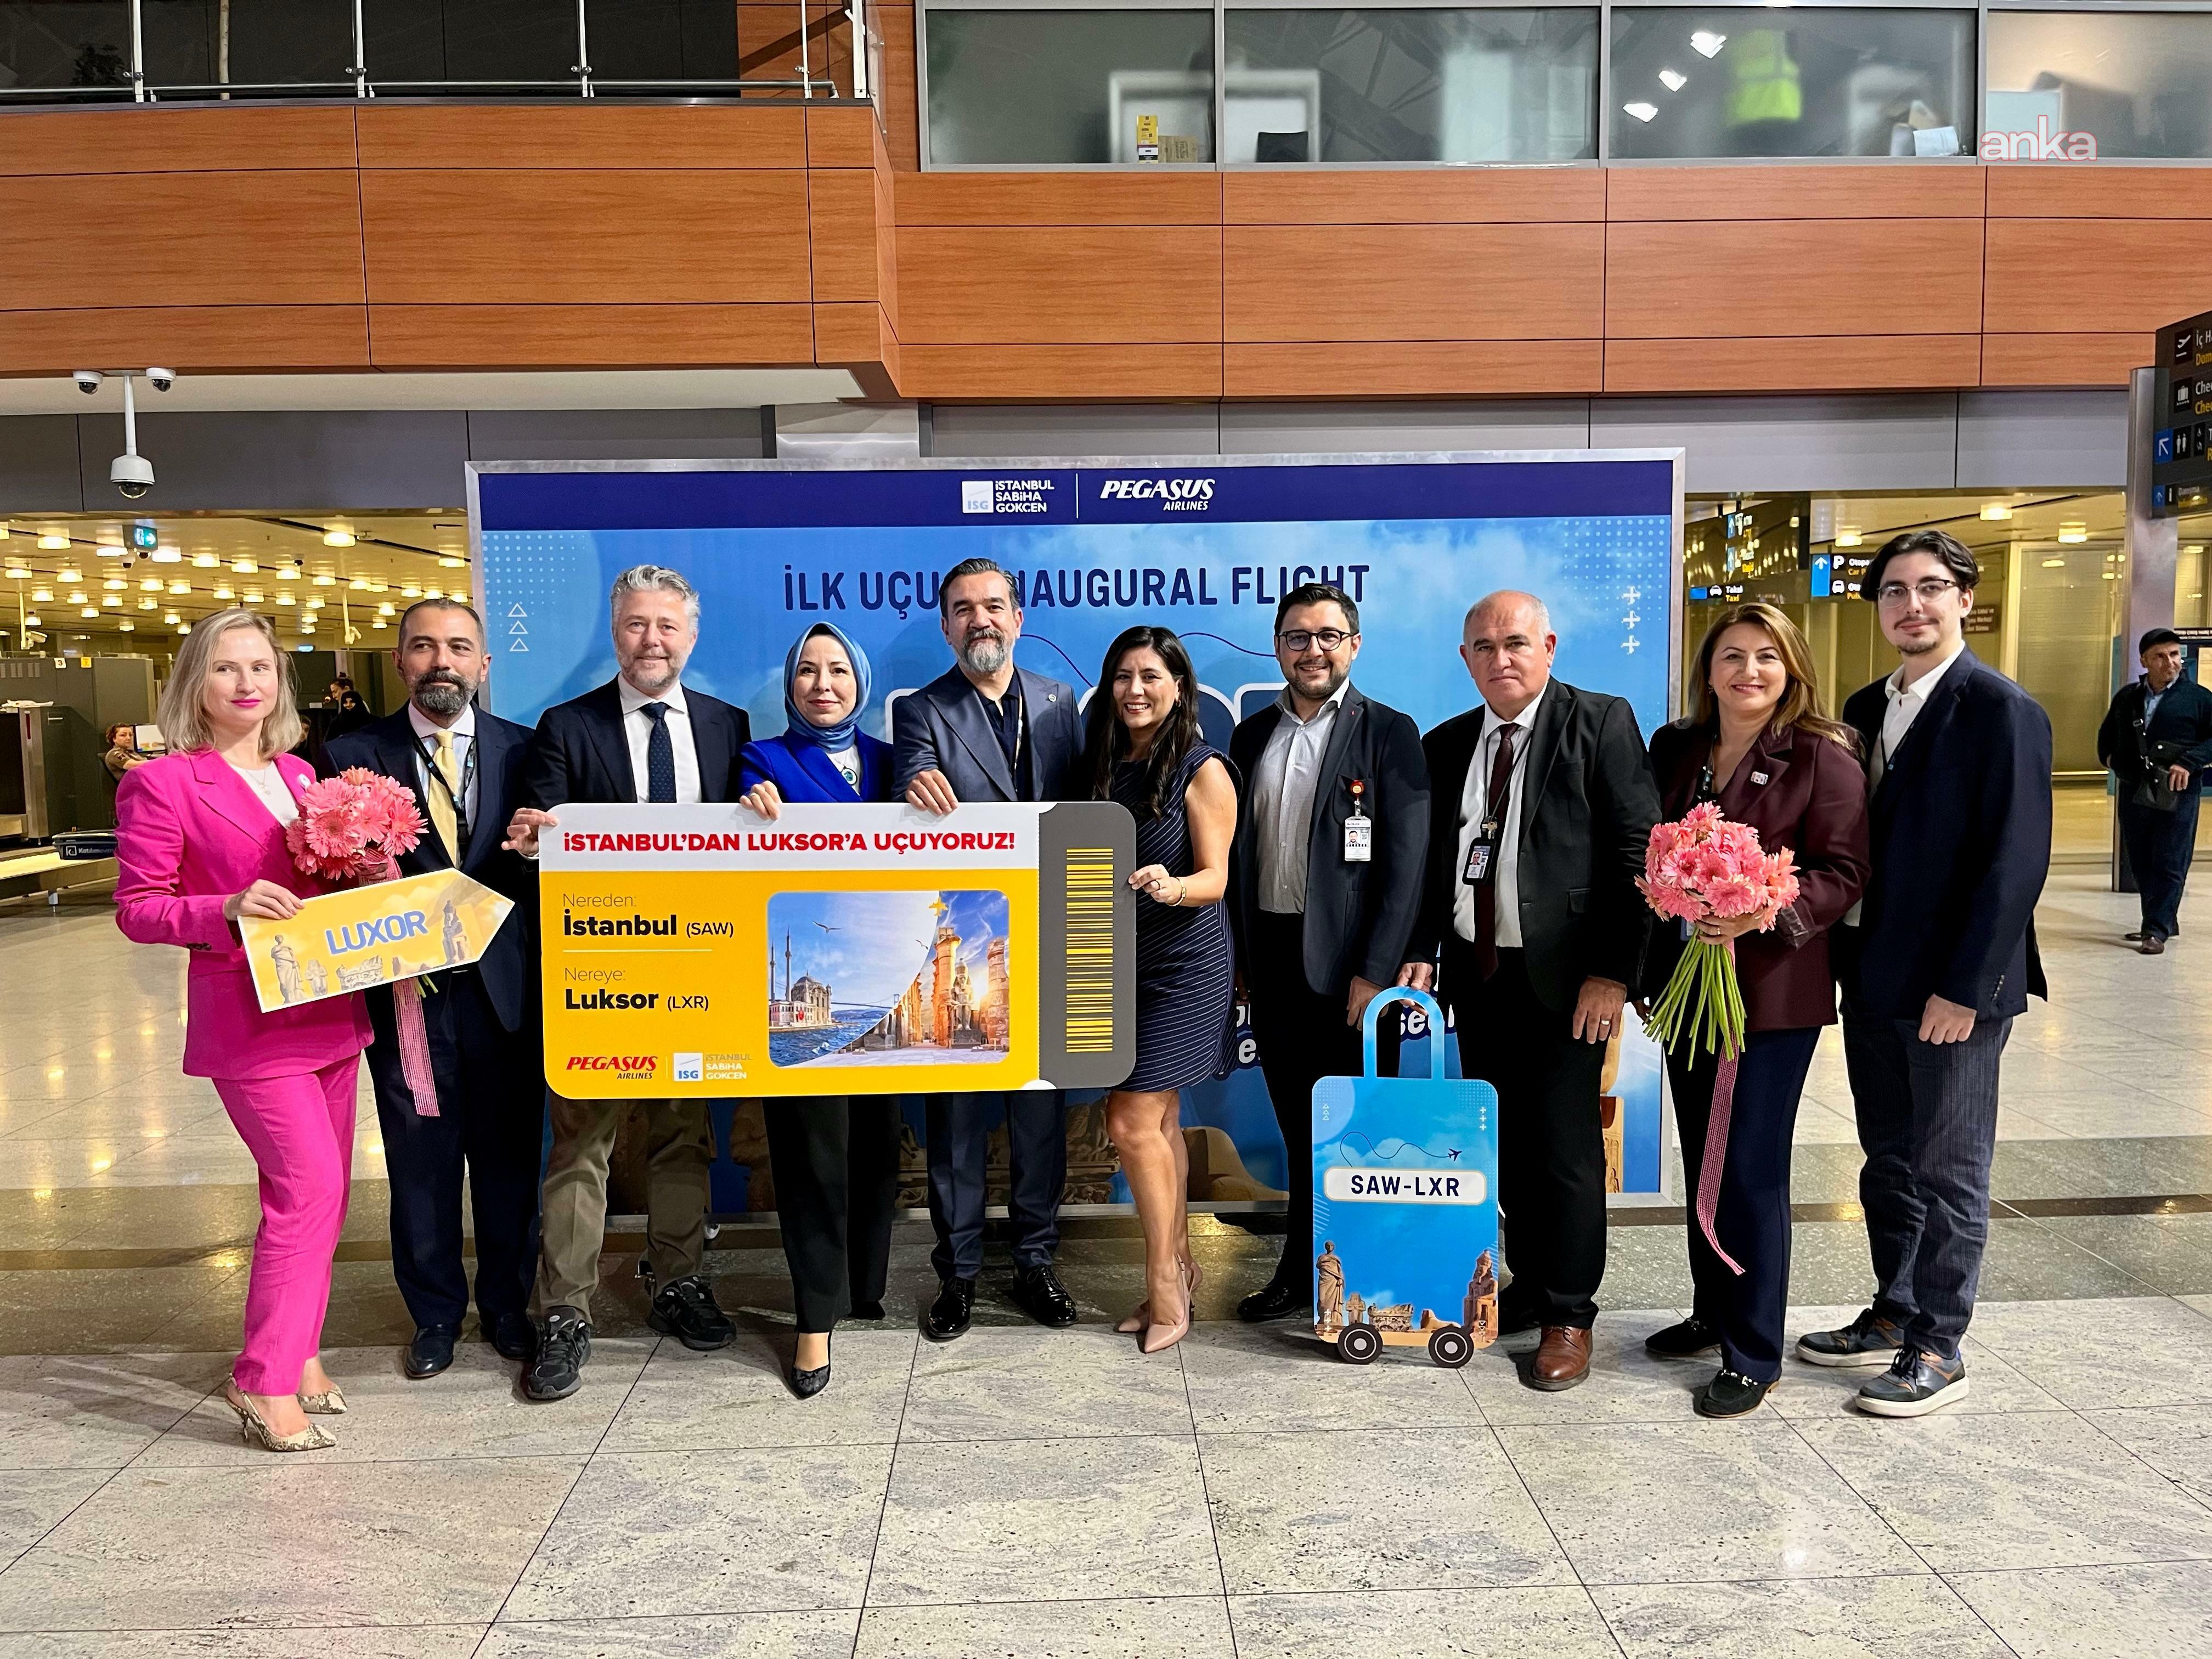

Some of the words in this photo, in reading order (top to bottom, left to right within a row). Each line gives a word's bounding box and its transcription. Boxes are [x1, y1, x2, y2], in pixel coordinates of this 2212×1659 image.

[1100, 478, 1216, 500] PEGASUS
[967, 500, 989, 510] ISG
[1163, 500, 1209, 511] AIRLINES
[784, 564, 846, 611] İLK
[860, 571, 940, 620] UÇU
[874, 832, 1015, 855] UÇUYORUZ!
[563, 893, 637, 907] Nereden:
[326, 910, 429, 956] LUXOR
[564, 909, 677, 936] İstanbul
[686, 922, 734, 938] (SAW)
[565, 967, 626, 984] Nereye:
[566, 989, 659, 1010] Luksor
[667, 996, 709, 1012] (LXR)
[566, 1055, 658, 1071] PEGASUS
[679, 1070, 698, 1079] ISG
[1351, 1174, 1460, 1197] SAW-LXR
